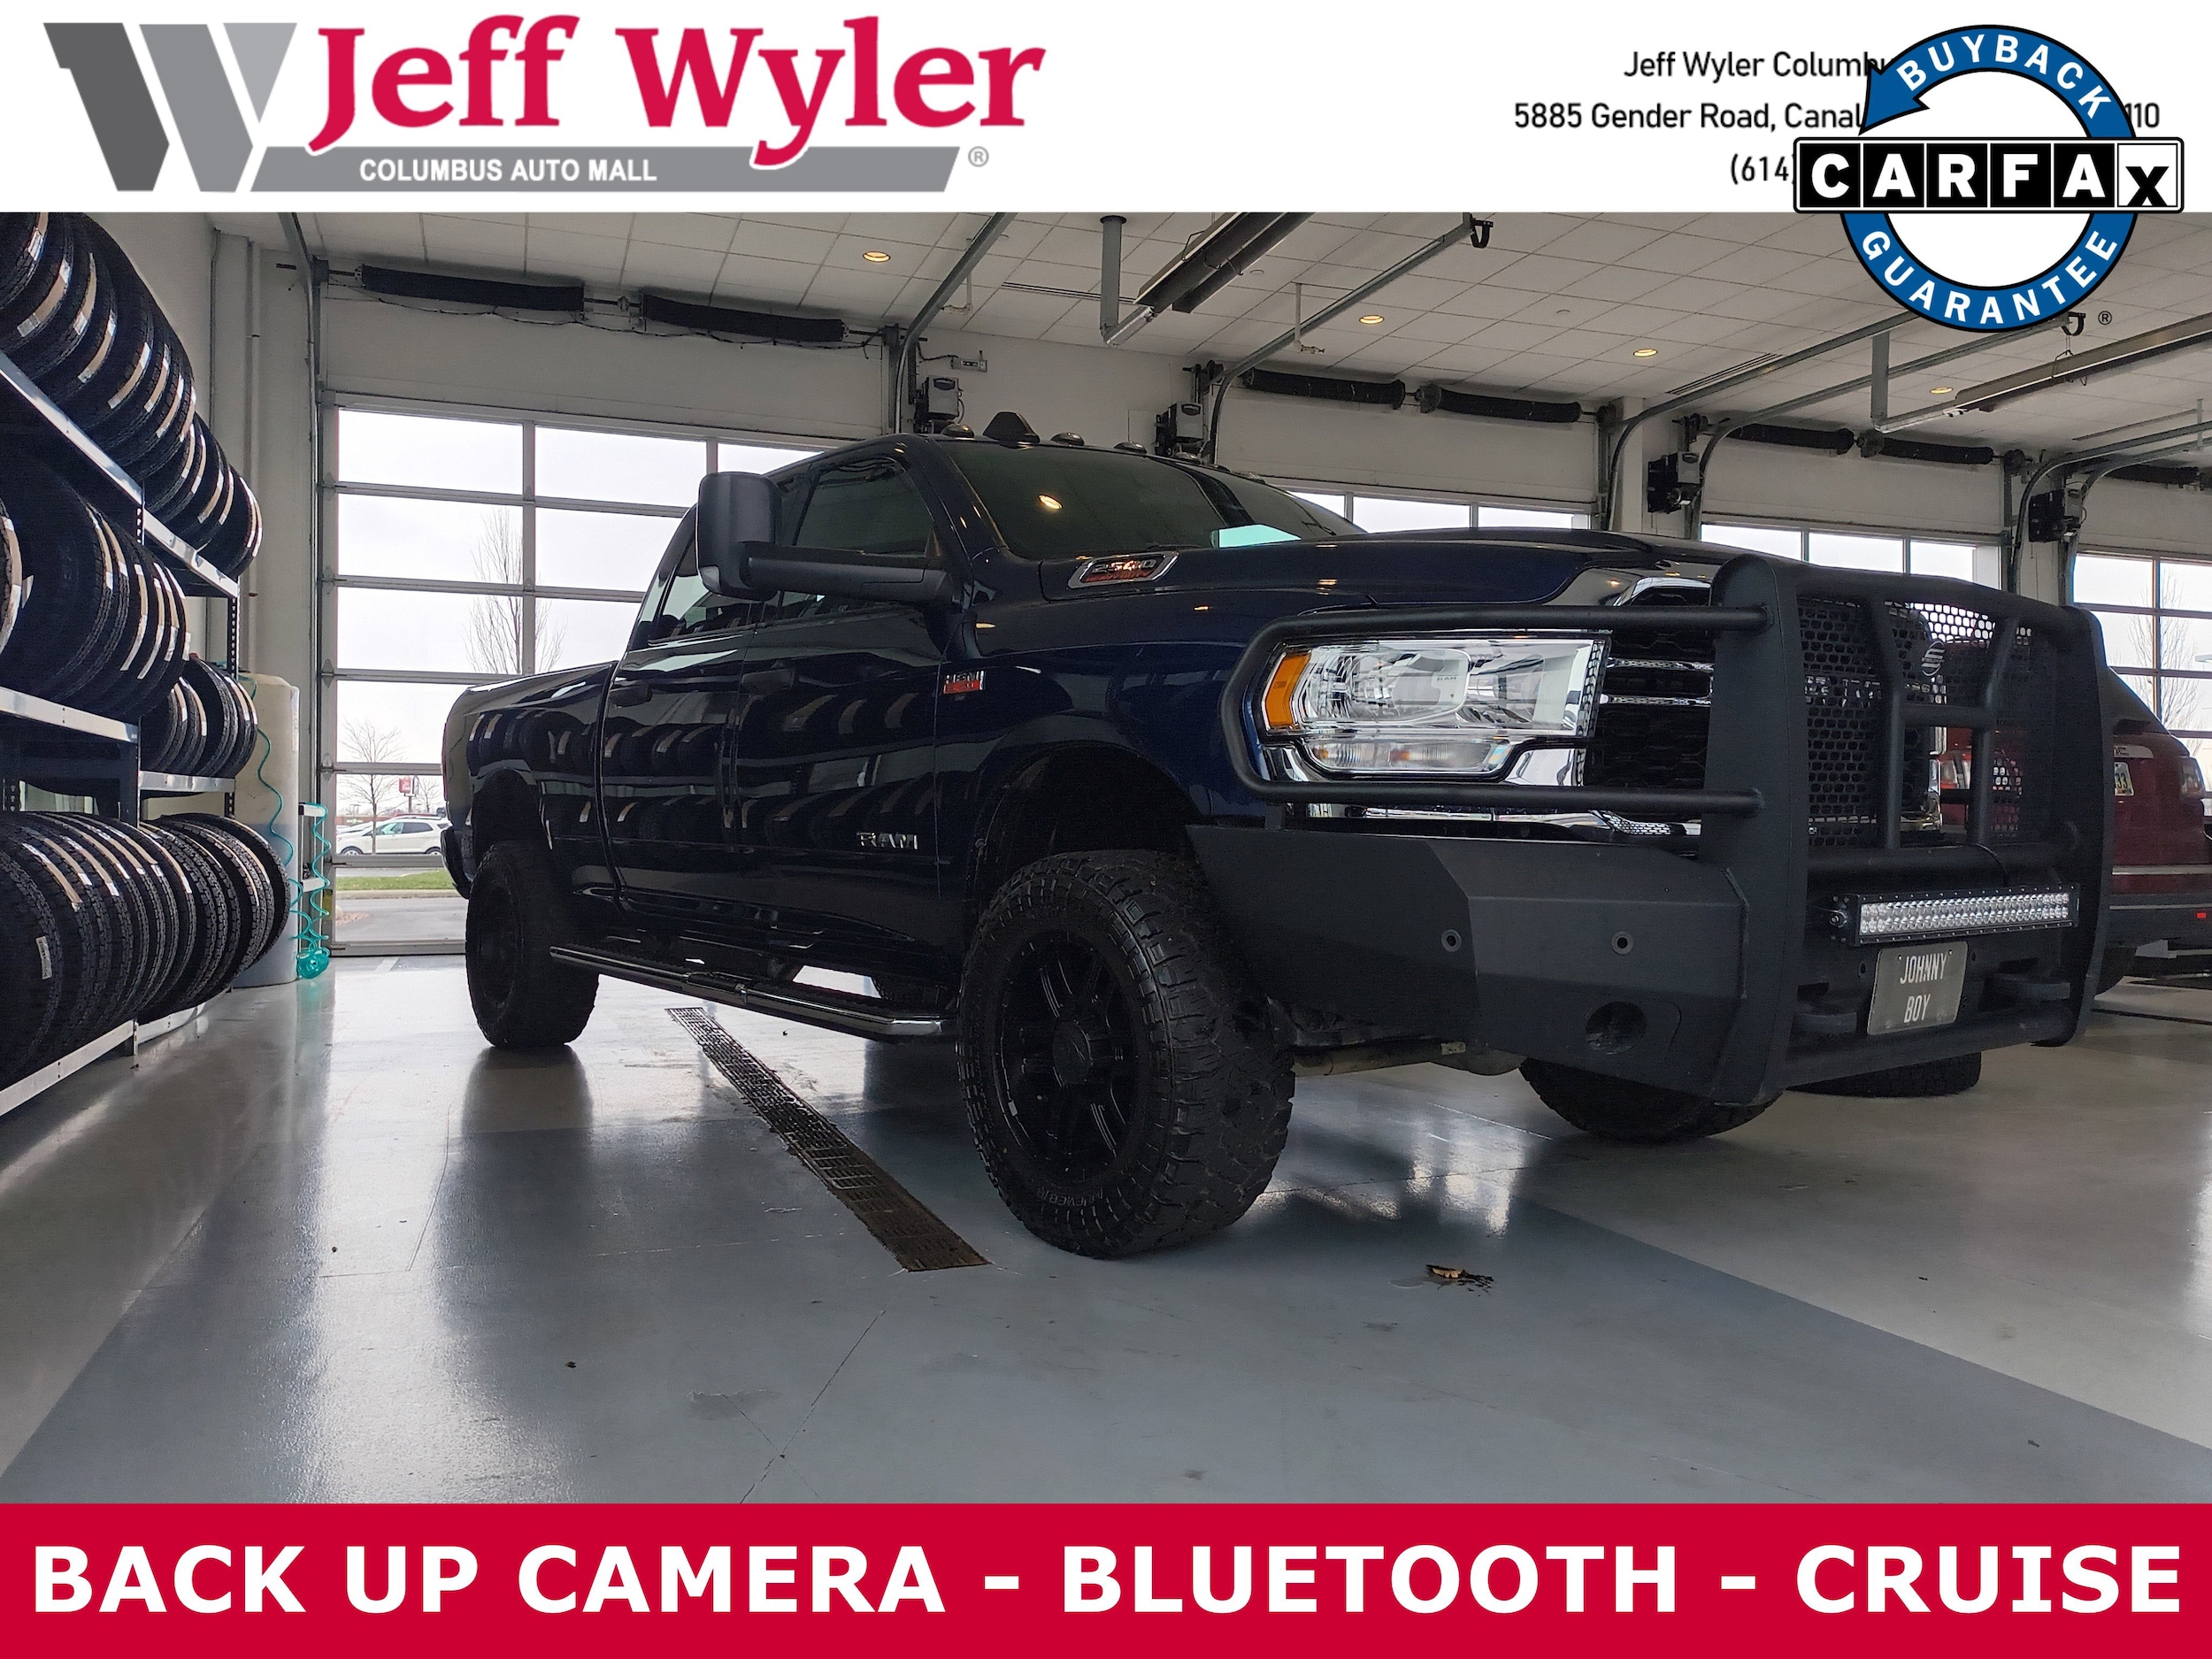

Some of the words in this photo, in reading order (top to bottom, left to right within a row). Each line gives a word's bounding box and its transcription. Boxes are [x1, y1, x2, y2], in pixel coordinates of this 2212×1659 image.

[856, 832, 918, 850] RAM
[1900, 953, 1947, 985] JOHNNY
[1903, 994, 1932, 1024] BOY
